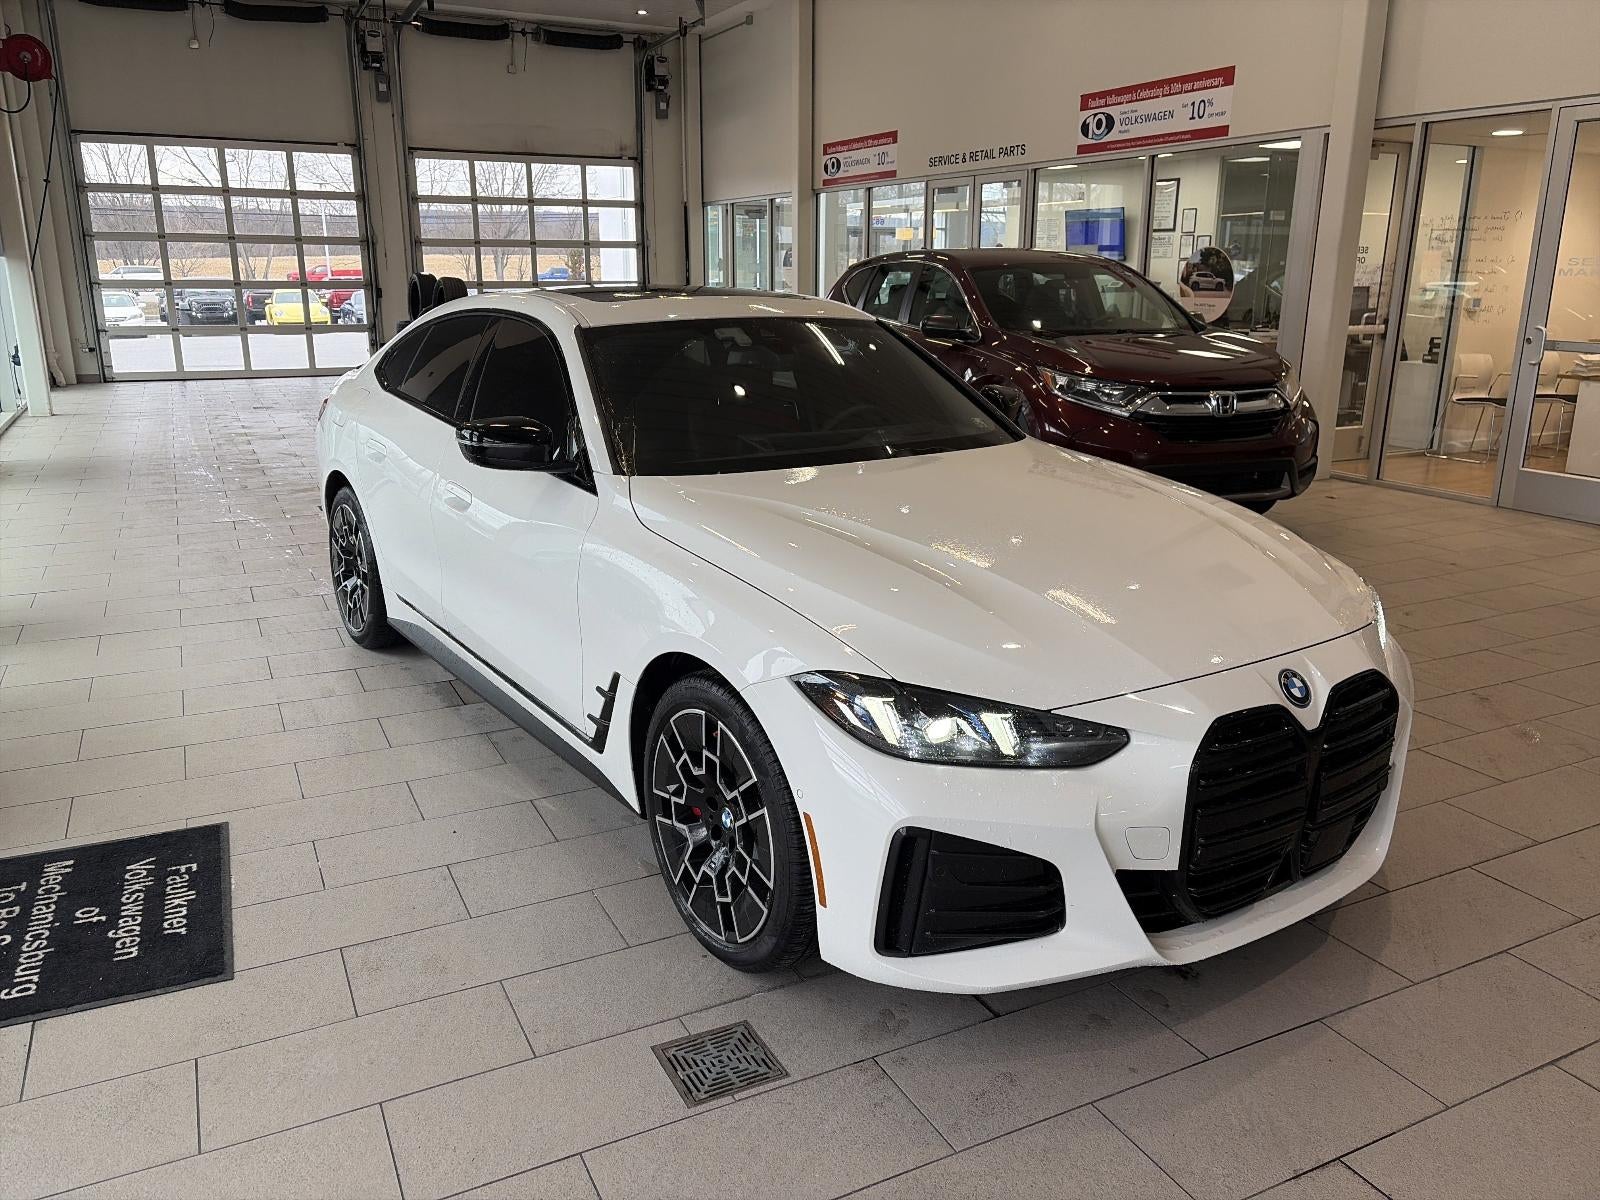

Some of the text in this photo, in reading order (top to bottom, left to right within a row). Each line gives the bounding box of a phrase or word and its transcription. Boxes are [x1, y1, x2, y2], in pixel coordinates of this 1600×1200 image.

[1137, 85, 1162, 100] Celebrating
[1182, 82, 1193, 94] year
[1086, 113, 1106, 139] 10
[1119, 109, 1175, 127] VOLKSWAGEN
[928, 143, 1026, 168] SERVICE & RETAIL PARTS
[107, 857, 156, 961] Volkswagen
[163, 863, 197, 935] Faulkner
[73, 906, 107, 924] of
[0, 859, 75, 1000] Mechanicsburg
